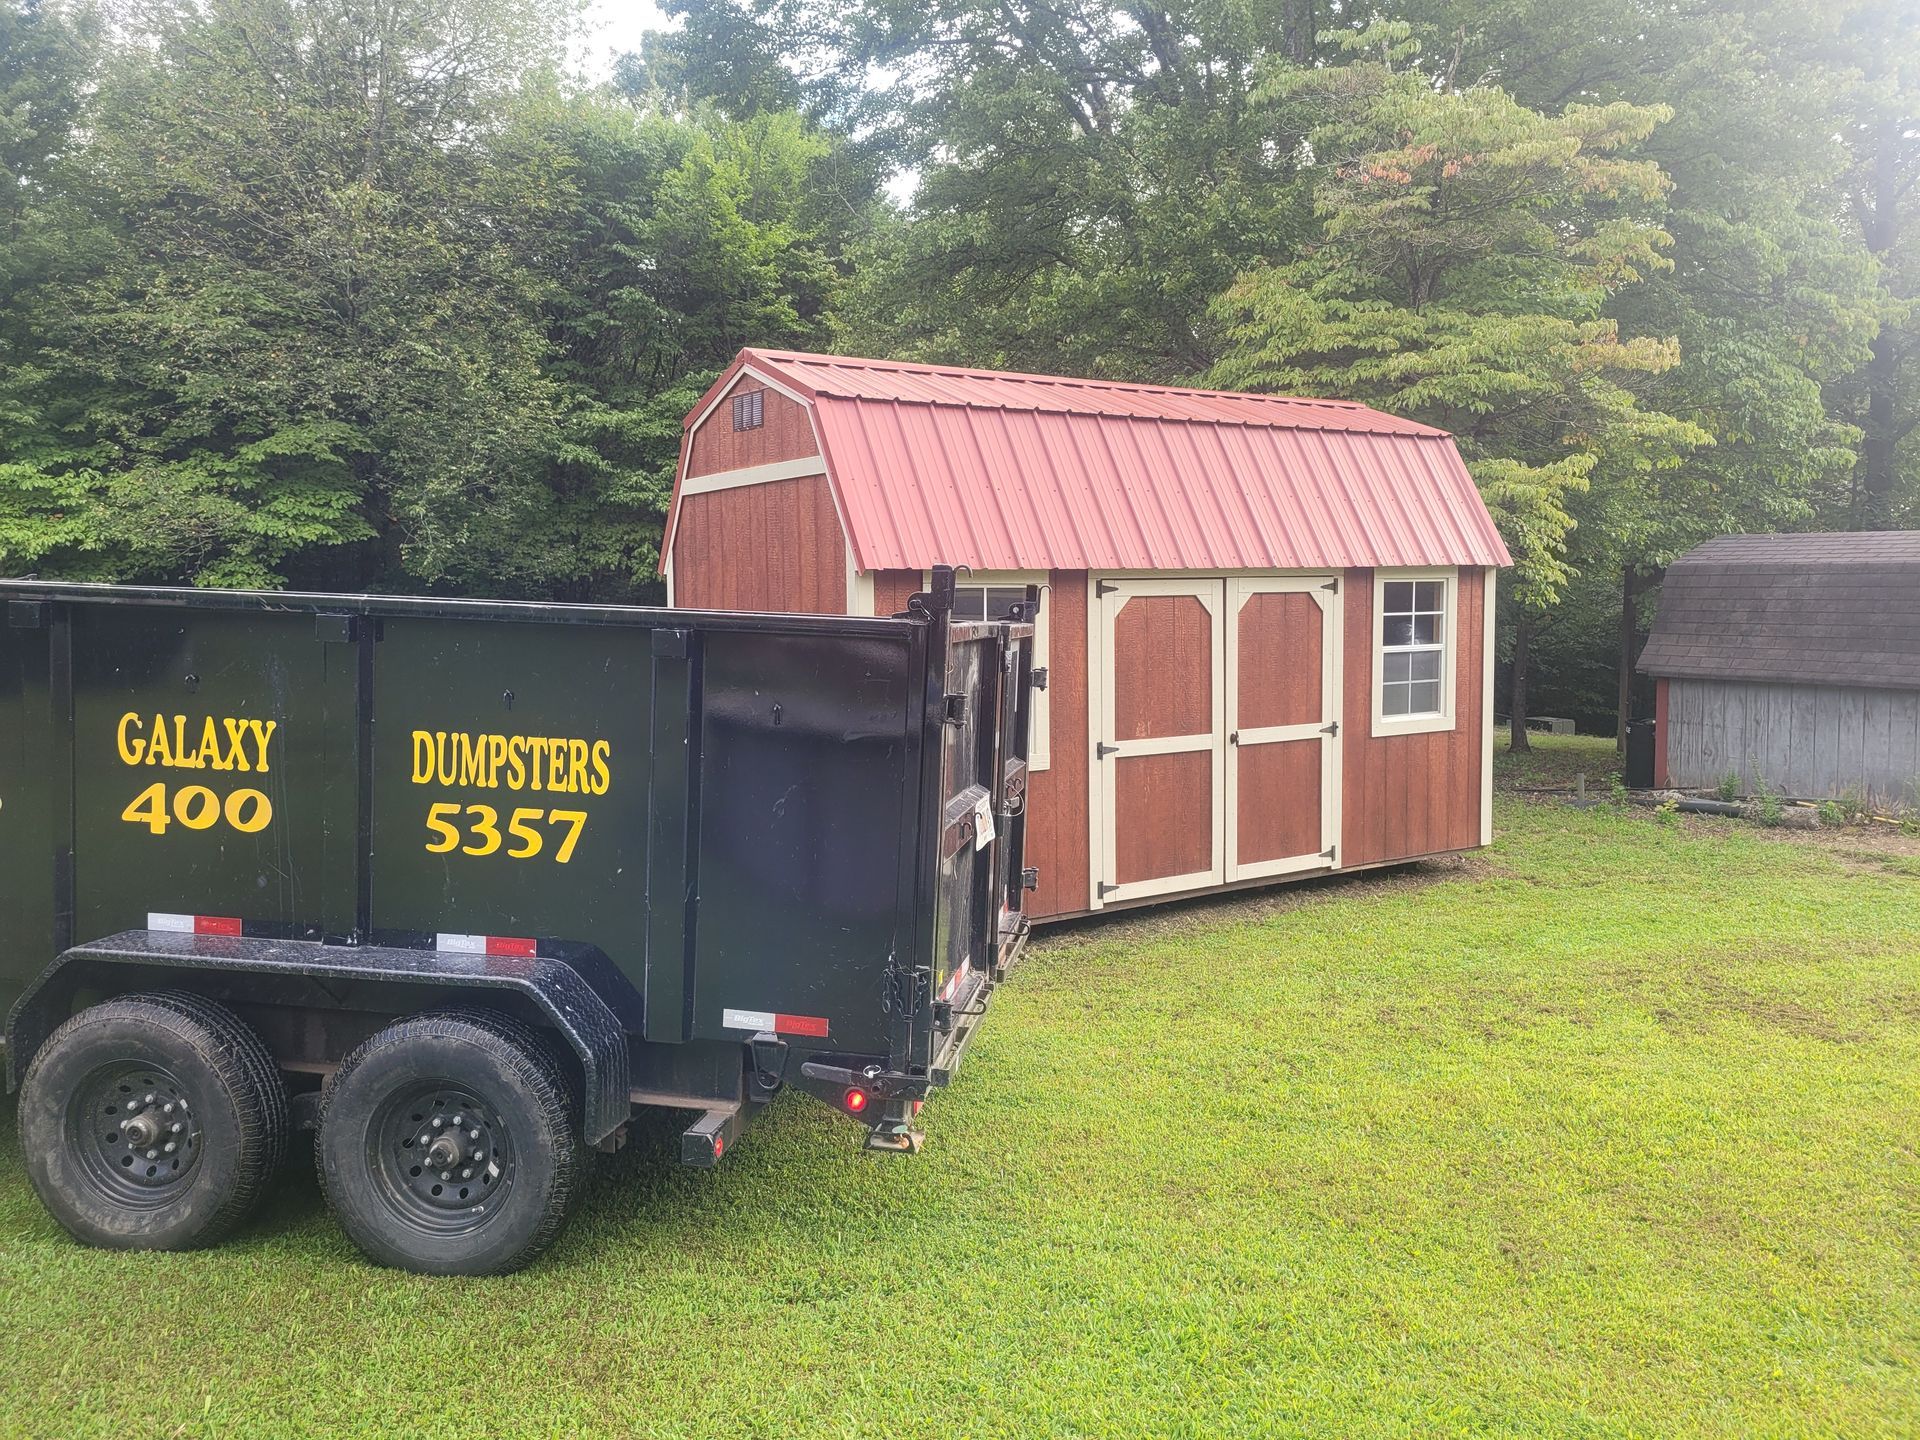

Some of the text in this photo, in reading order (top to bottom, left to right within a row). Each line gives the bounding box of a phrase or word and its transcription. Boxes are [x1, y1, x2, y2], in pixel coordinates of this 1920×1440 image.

[117, 712, 610, 796] GALAXY DUMPSTERS
[121, 782, 588, 864] 400 5357
